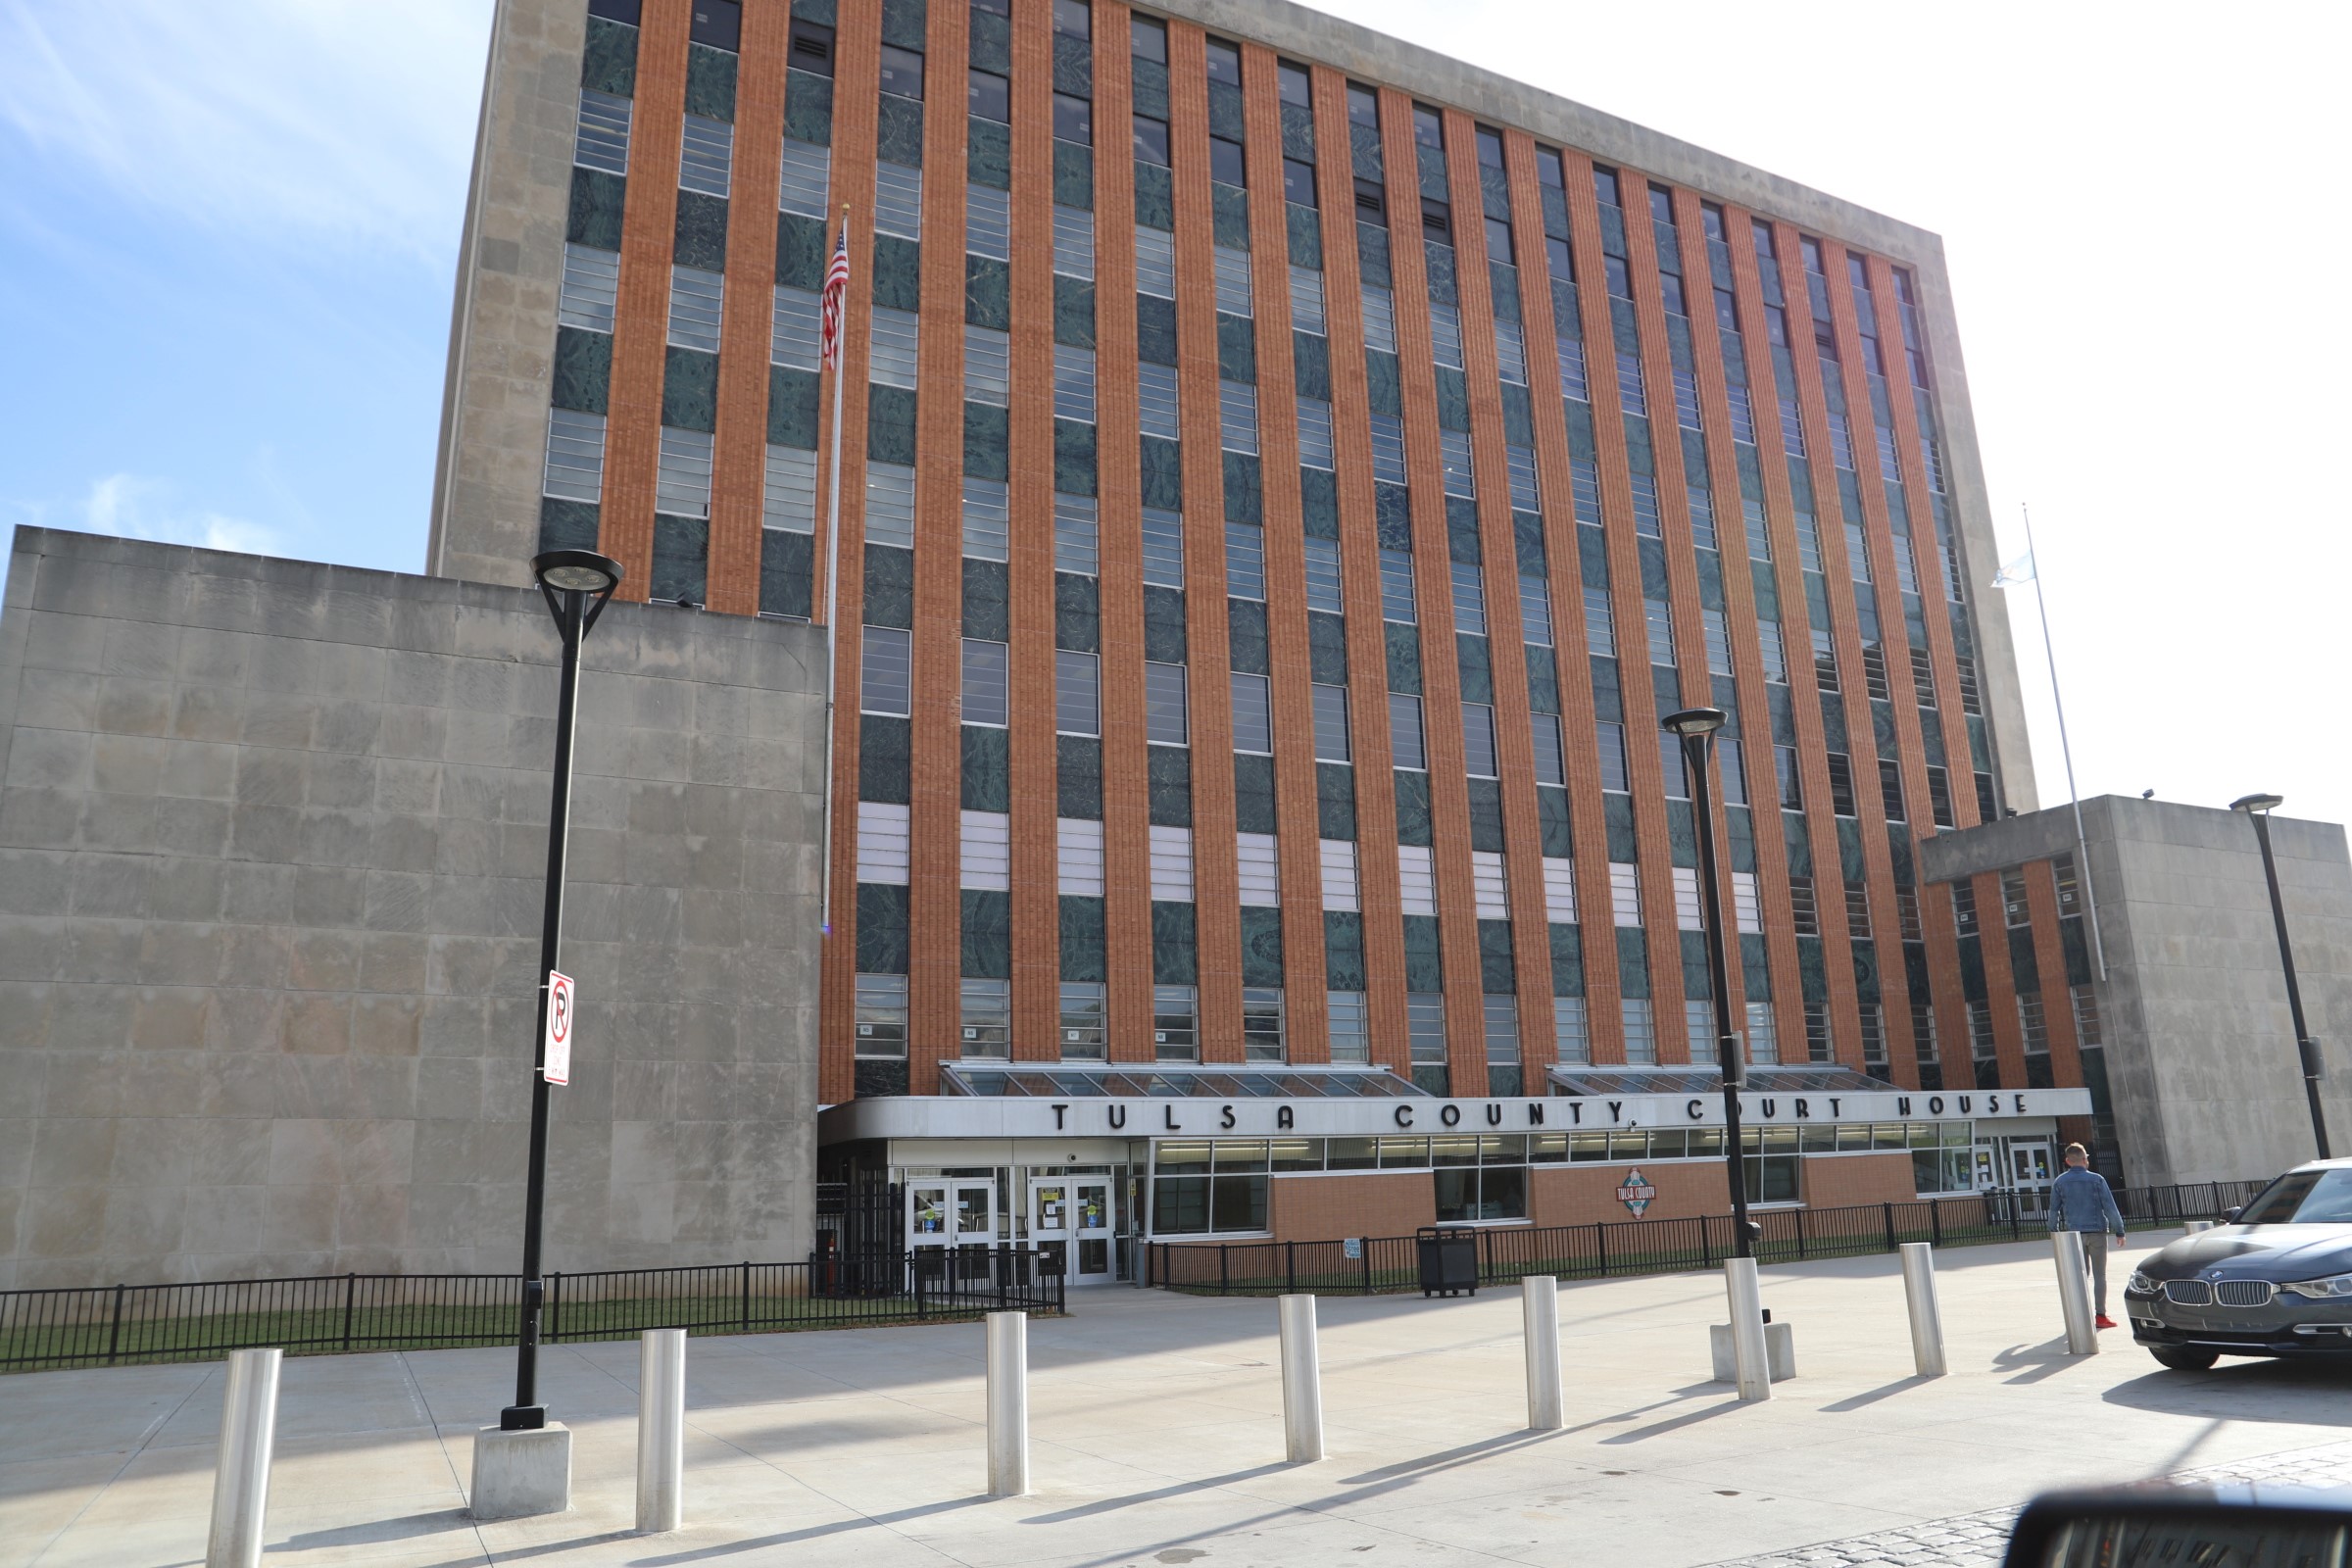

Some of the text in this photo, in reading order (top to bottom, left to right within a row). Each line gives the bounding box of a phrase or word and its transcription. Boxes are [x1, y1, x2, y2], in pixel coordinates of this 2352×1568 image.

[1052, 1094, 2028, 1130] TULSA COUNTY CURT HOUSE
[1617, 1186, 1655, 1200] TULSA COUNTY
